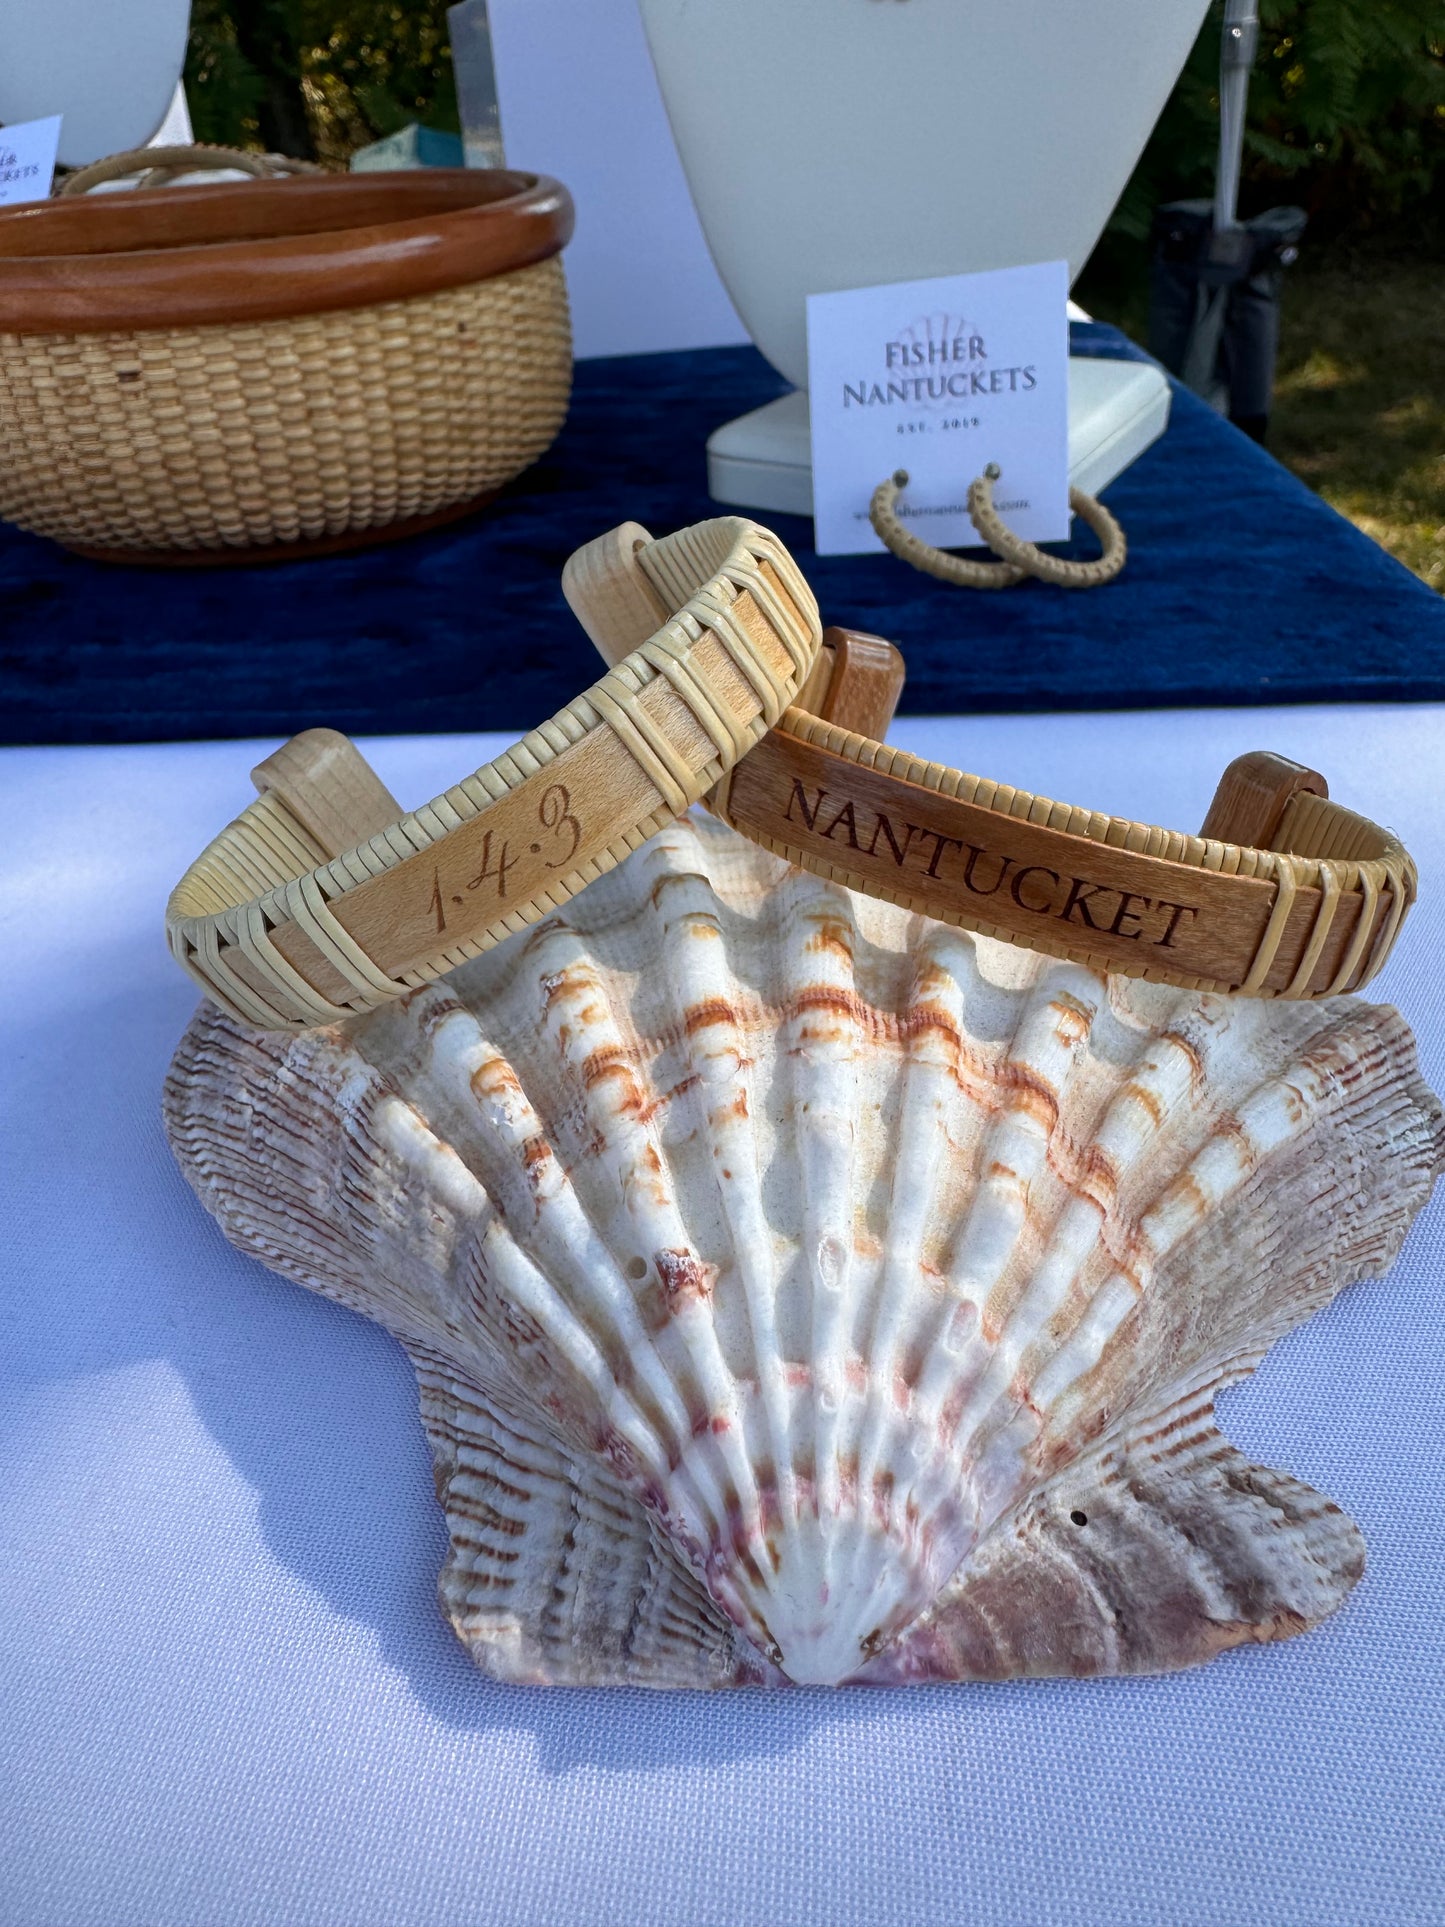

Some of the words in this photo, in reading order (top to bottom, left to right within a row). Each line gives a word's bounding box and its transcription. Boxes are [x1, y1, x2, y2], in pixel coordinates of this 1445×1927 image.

[843, 364, 1038, 408] NANTUCKETS
[885, 334, 988, 368] FISHER
[427, 784, 581, 933] 1.4.3
[783, 777, 1199, 948] NANTUCKET
